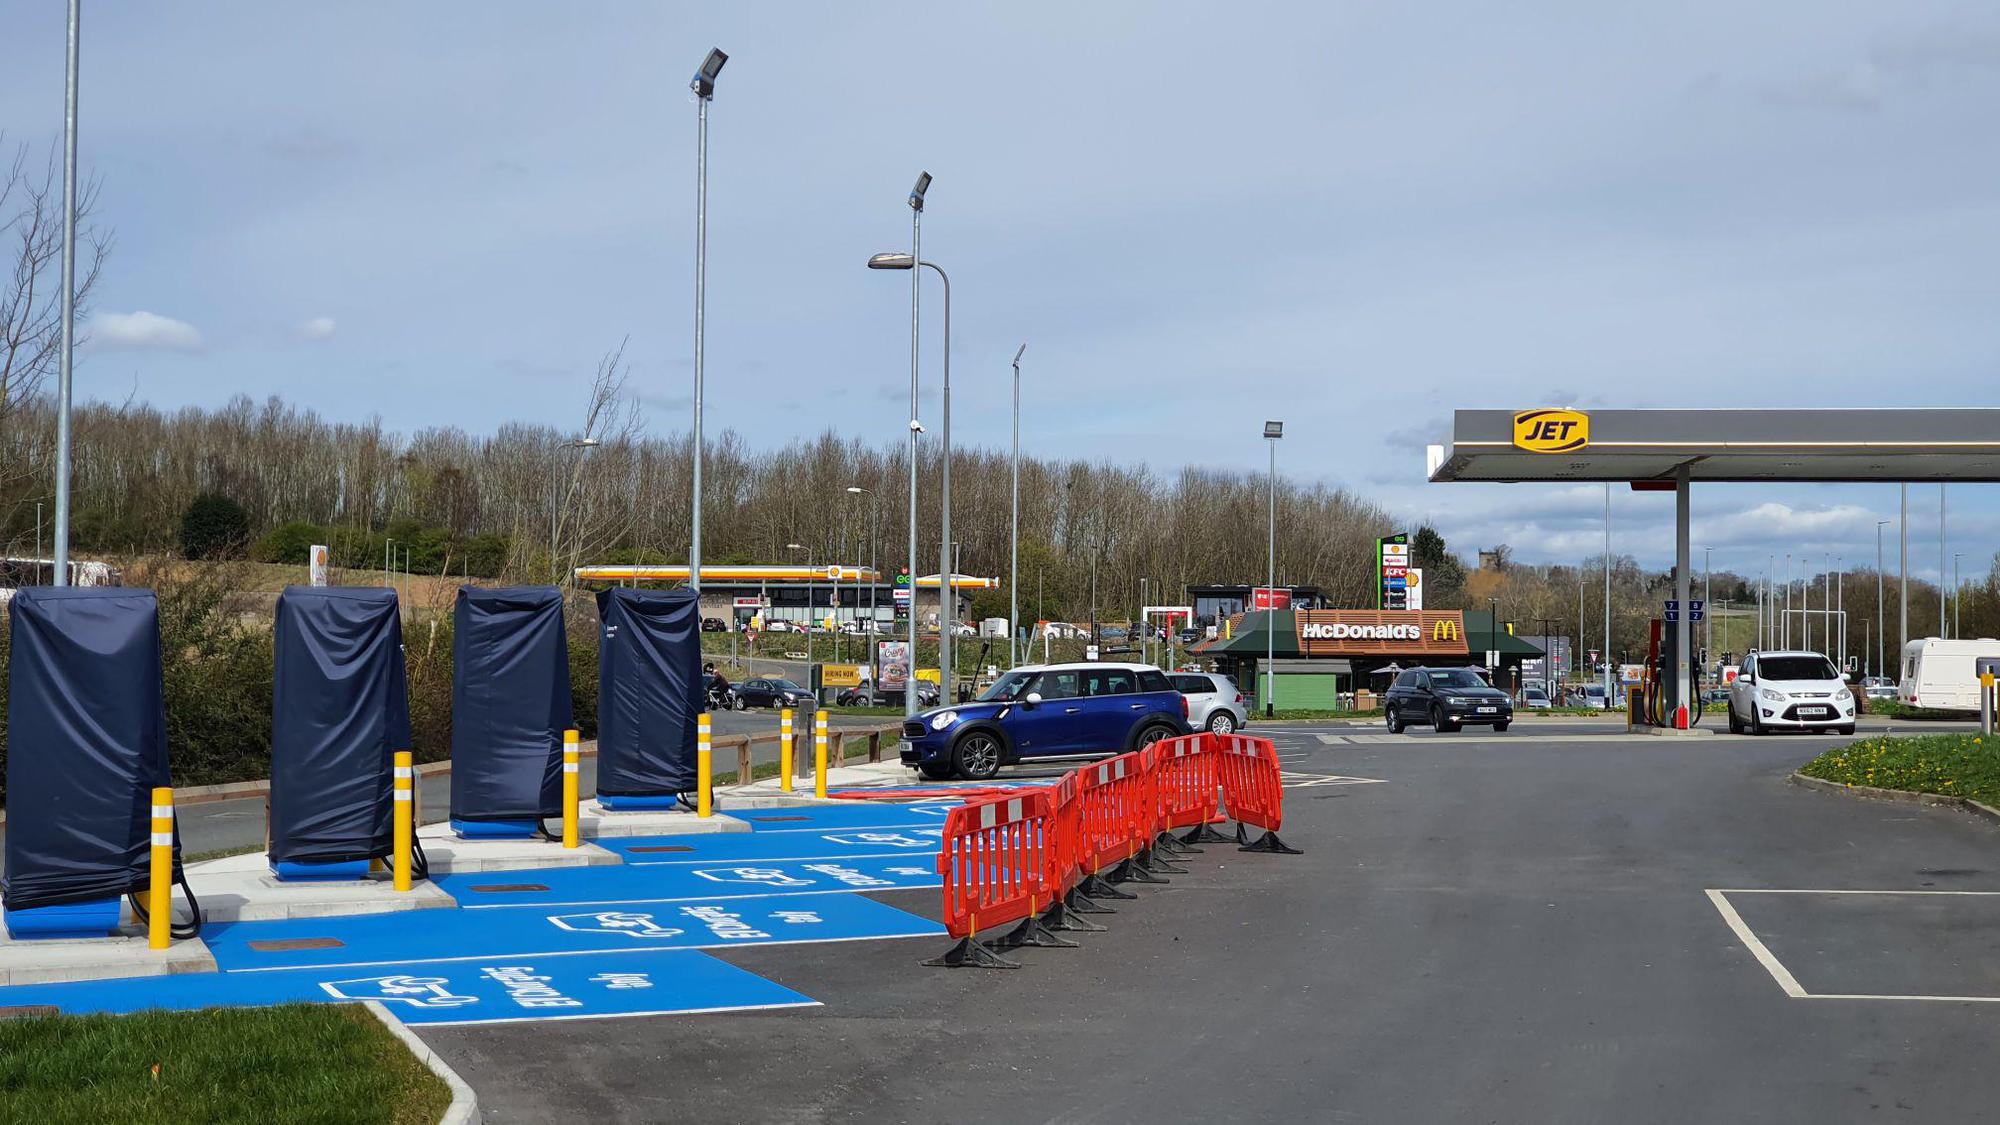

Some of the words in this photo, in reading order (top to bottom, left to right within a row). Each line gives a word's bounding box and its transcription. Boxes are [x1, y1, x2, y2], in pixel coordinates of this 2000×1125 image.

[1524, 421, 1578, 440] JET
[1385, 568, 1406, 577] KFC
[1302, 623, 1420, 640] McDonald's
